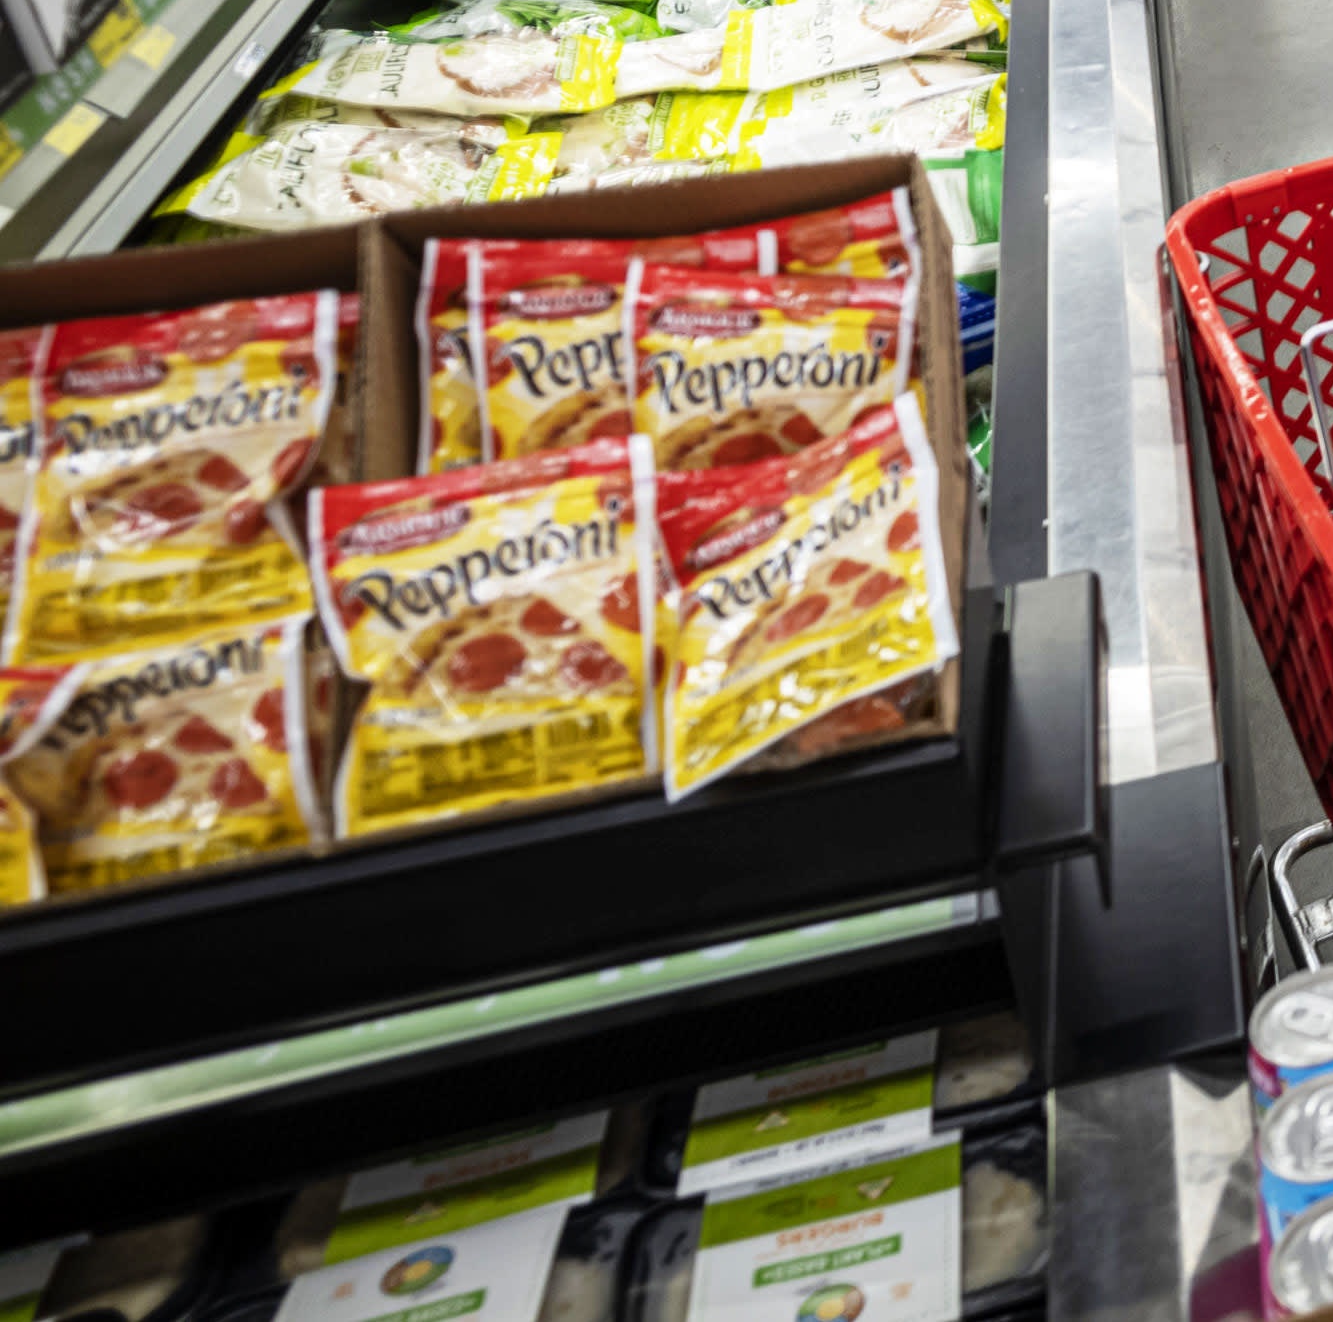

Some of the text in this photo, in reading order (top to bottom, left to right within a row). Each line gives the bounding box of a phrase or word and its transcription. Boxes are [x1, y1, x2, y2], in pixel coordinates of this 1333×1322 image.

[57, 363, 304, 454] Pepperoni
[642, 334, 886, 414] Pepperoni
[344, 495, 622, 630] Pepperoni
